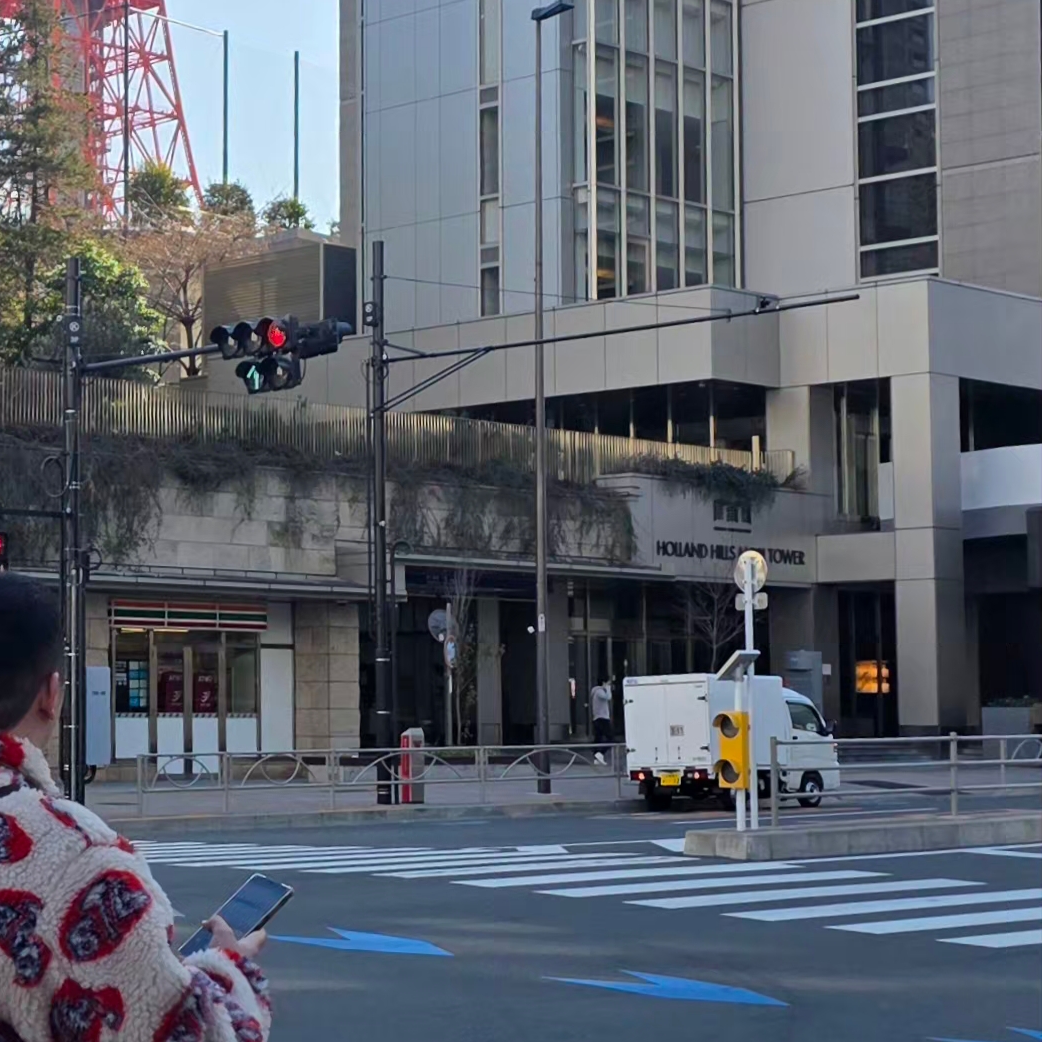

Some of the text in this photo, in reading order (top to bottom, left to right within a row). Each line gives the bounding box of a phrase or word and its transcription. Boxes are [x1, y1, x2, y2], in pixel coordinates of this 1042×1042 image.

[656, 540, 708, 559] HOLLAND
[710, 544, 736, 560] HILLS
[768, 548, 805, 565] TOWER
